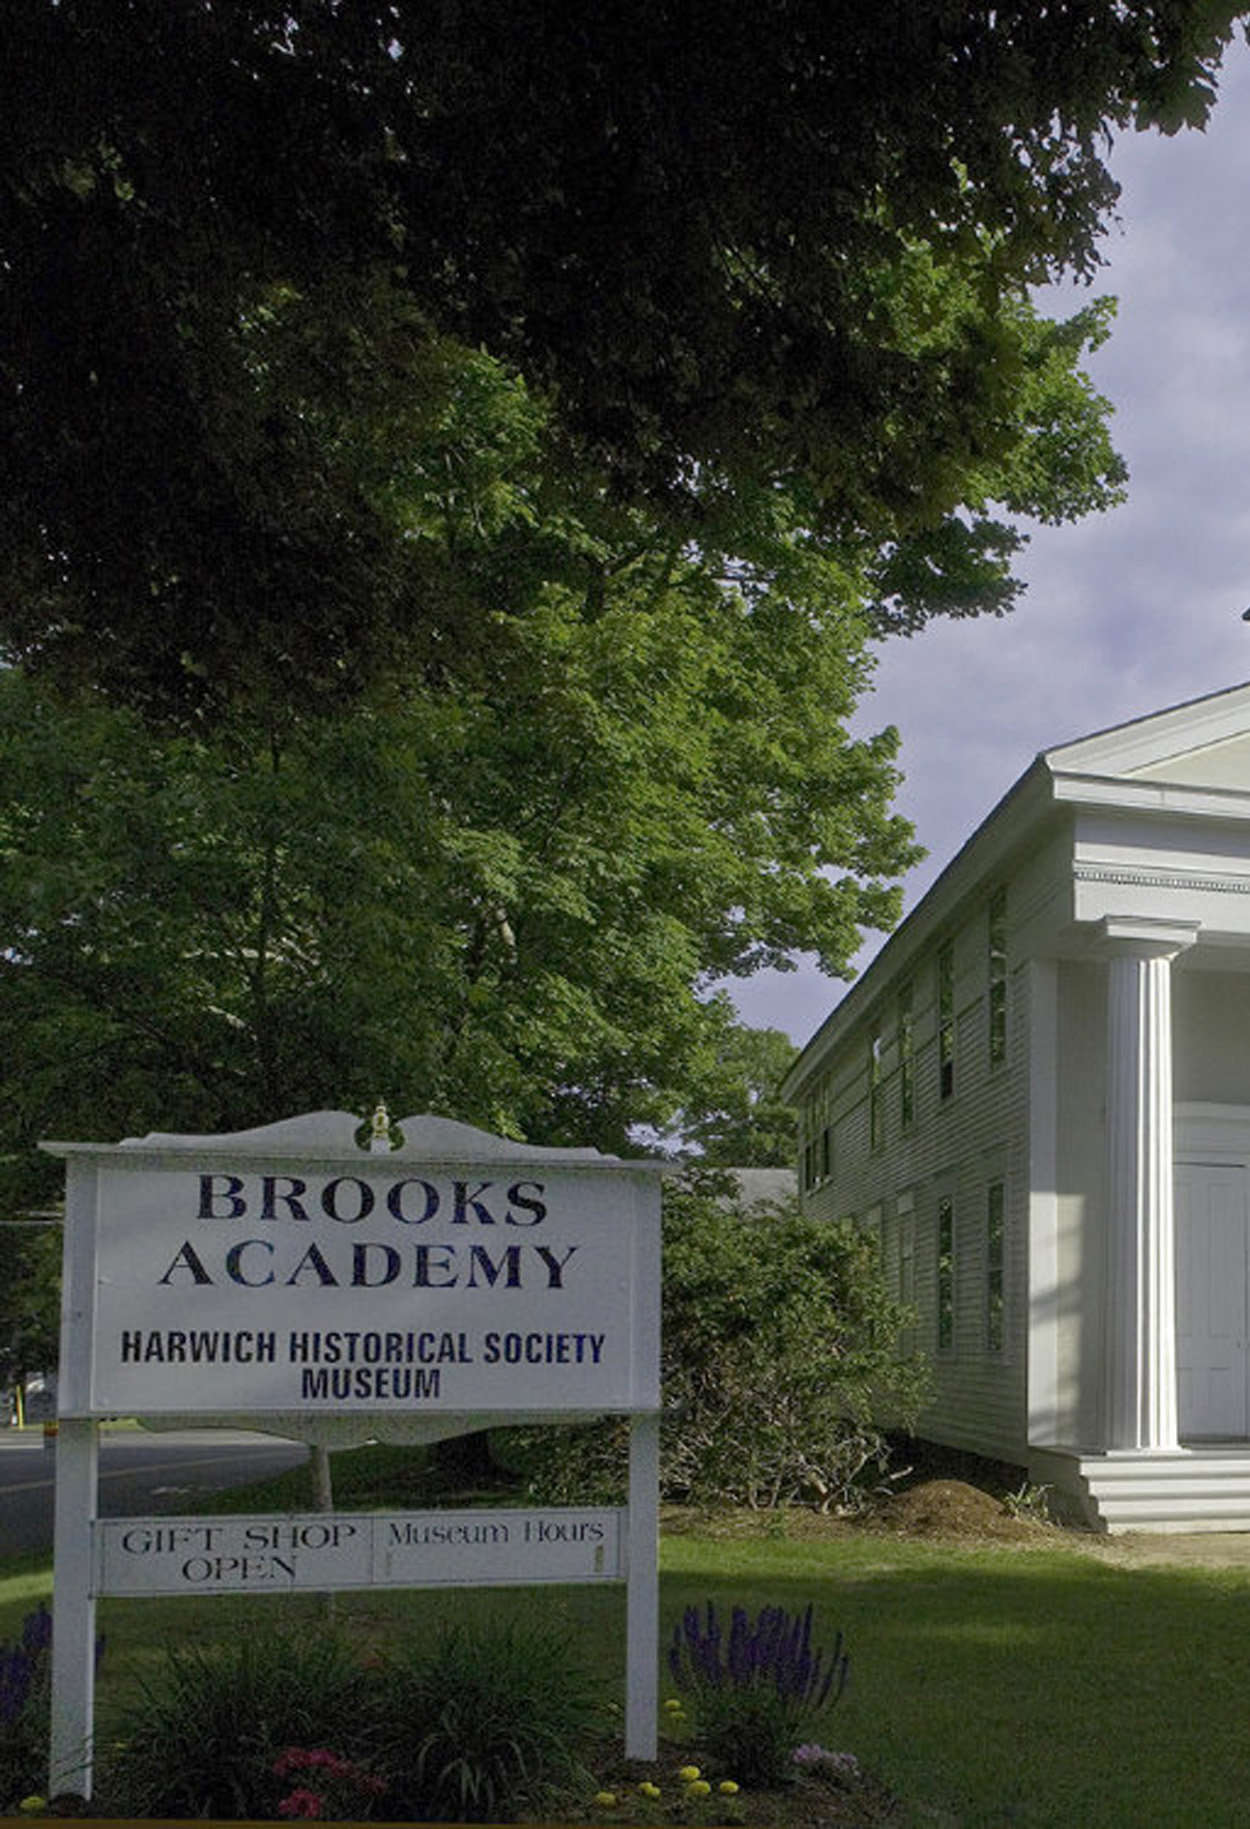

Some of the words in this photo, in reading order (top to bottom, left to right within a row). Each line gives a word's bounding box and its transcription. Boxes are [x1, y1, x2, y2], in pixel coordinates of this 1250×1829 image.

[196, 1173, 548, 1227] BROOKS
[157, 1239, 581, 1289] ACADEMY
[120, 1330, 277, 1364] HARWICH
[288, 1331, 475, 1364] HISTORICAL
[483, 1332, 606, 1365] SOCIETY
[300, 1367, 441, 1400] MUSEUM
[121, 1525, 223, 1555] GIFT
[243, 1523, 357, 1551] SHOP
[388, 1520, 510, 1546] Museum
[523, 1518, 606, 1543] Hours
[181, 1554, 298, 1582] OPEN
